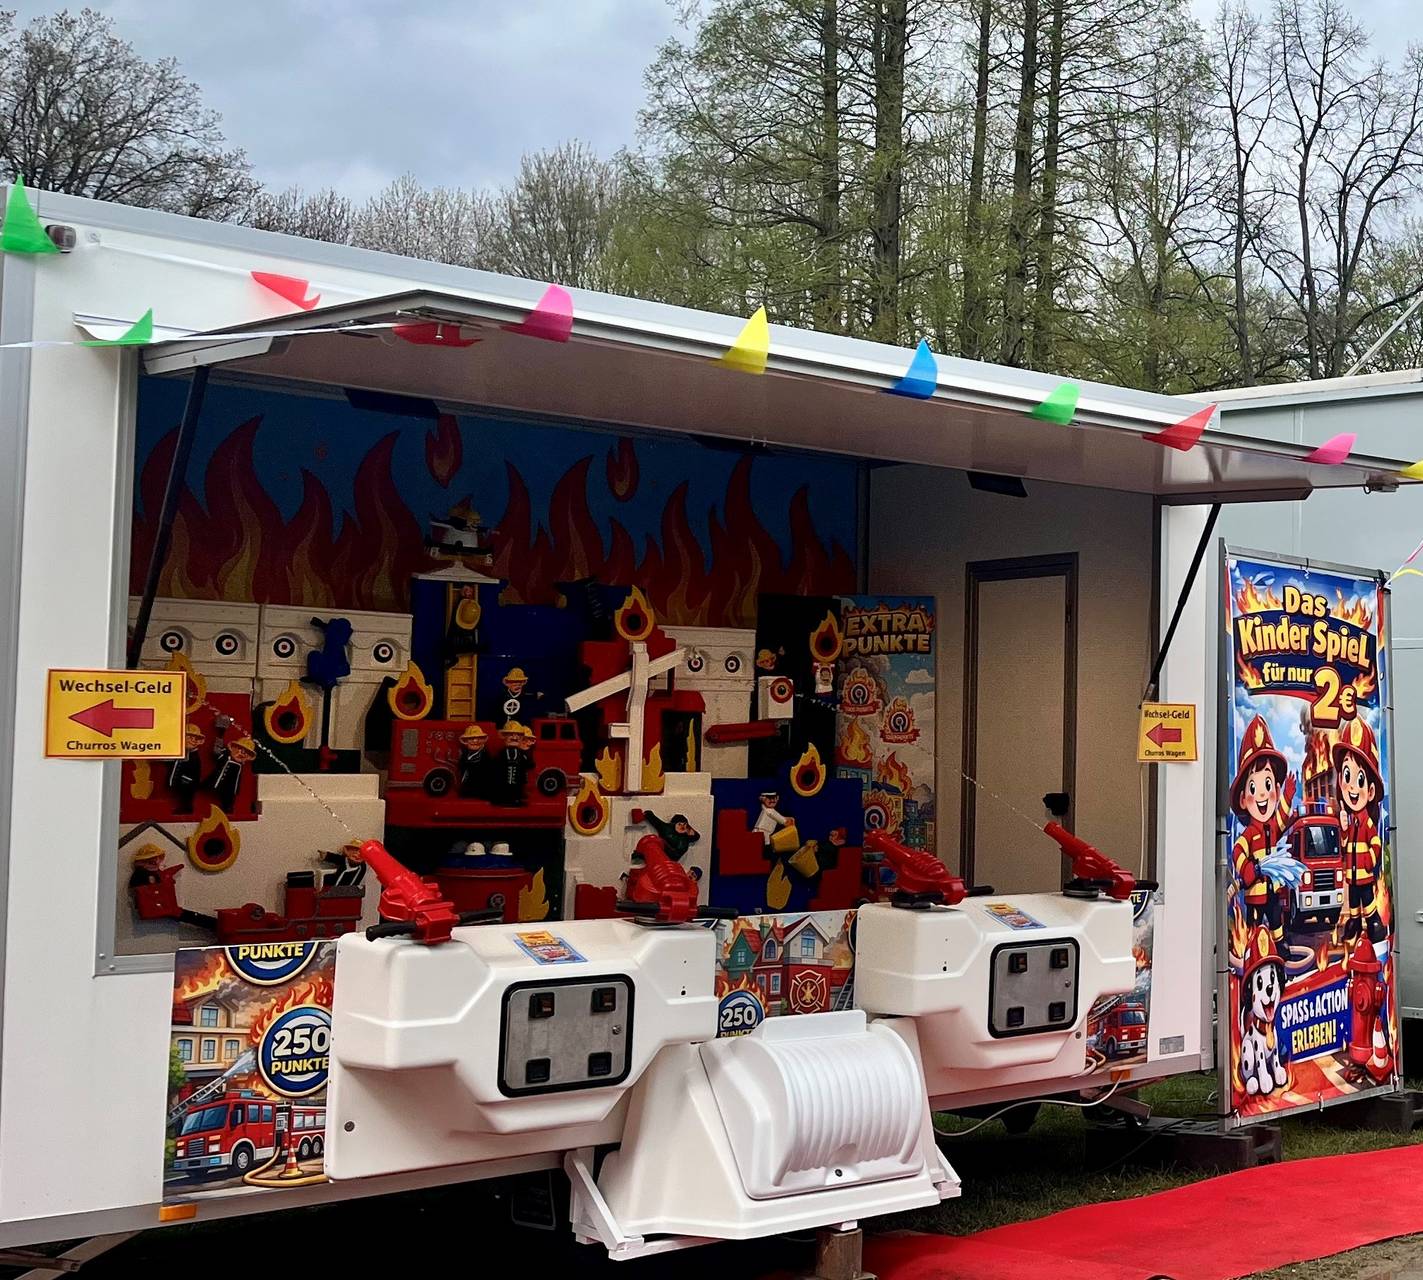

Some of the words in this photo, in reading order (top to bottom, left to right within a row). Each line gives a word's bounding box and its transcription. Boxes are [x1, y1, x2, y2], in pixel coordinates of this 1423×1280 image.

[1283, 586, 1327, 618] Das
[847, 613, 925, 636] EXTRA
[1238, 616, 1309, 655] Kinder
[842, 634, 930, 656] PUNKTE
[1262, 662, 1285, 682] für
[1287, 667, 1313, 682] nur
[59, 680, 172, 694] Wechsel-Geld
[1144, 709, 1190, 719] Wechsel-Geld
[66, 740, 117, 751] Churros
[120, 741, 161, 752] Wagen
[238, 943, 304, 960] PUNKTE
[722, 1005, 757, 1027] 250
[1280, 998, 1309, 1029] SPASS
[1315, 987, 1348, 1018] ACTION
[273, 1025, 331, 1057] 250
[1291, 1018, 1337, 1055] ERLEBEN!
[271, 1058, 329, 1075] PUNKTE
